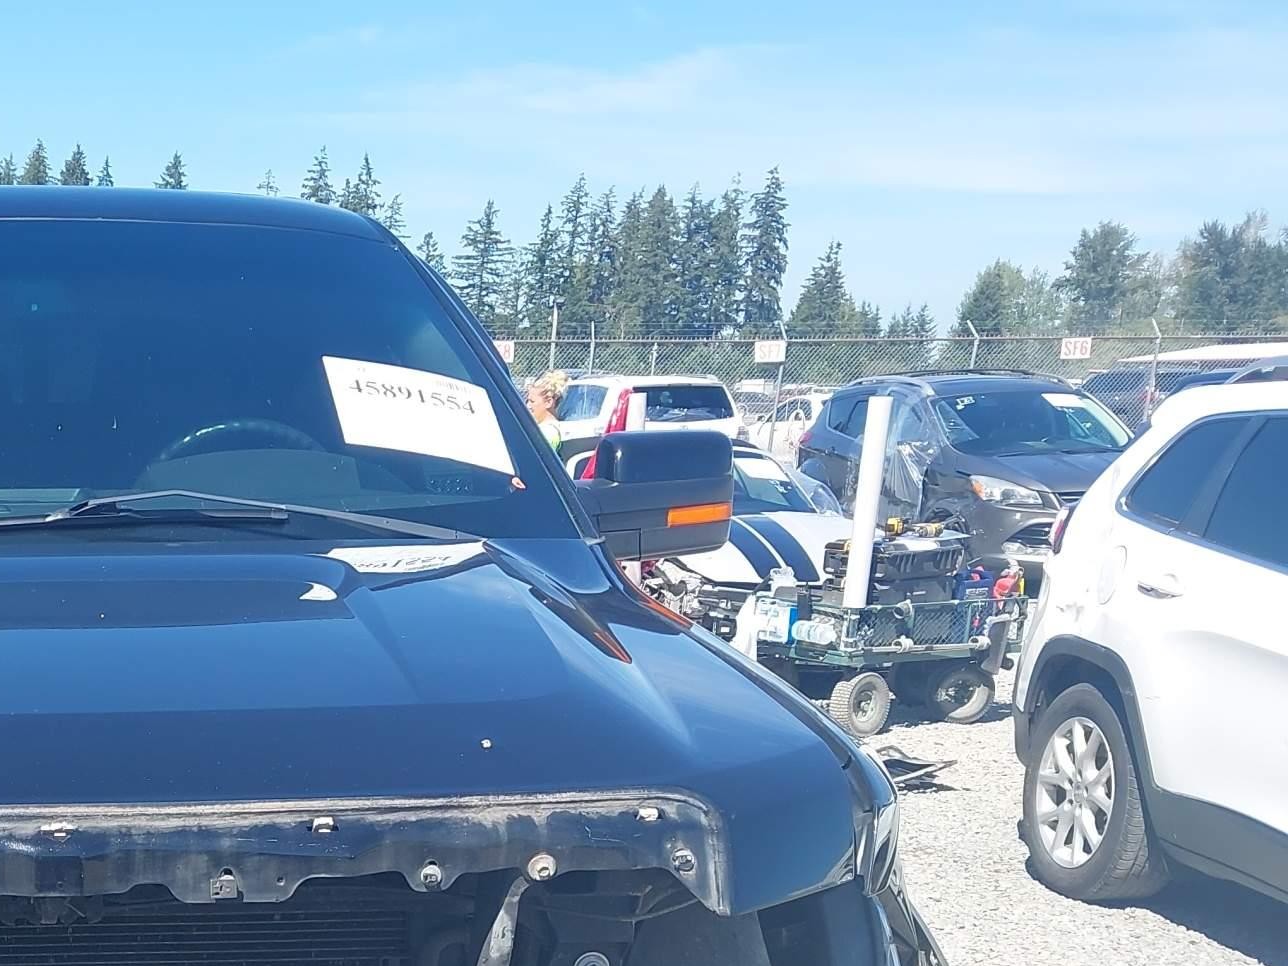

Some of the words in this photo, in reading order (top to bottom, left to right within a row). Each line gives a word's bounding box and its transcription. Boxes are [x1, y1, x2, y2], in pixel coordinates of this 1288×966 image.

[759, 343, 781, 360] SF7
[1063, 340, 1089, 356] SF6
[349, 378, 476, 415] 45891554
